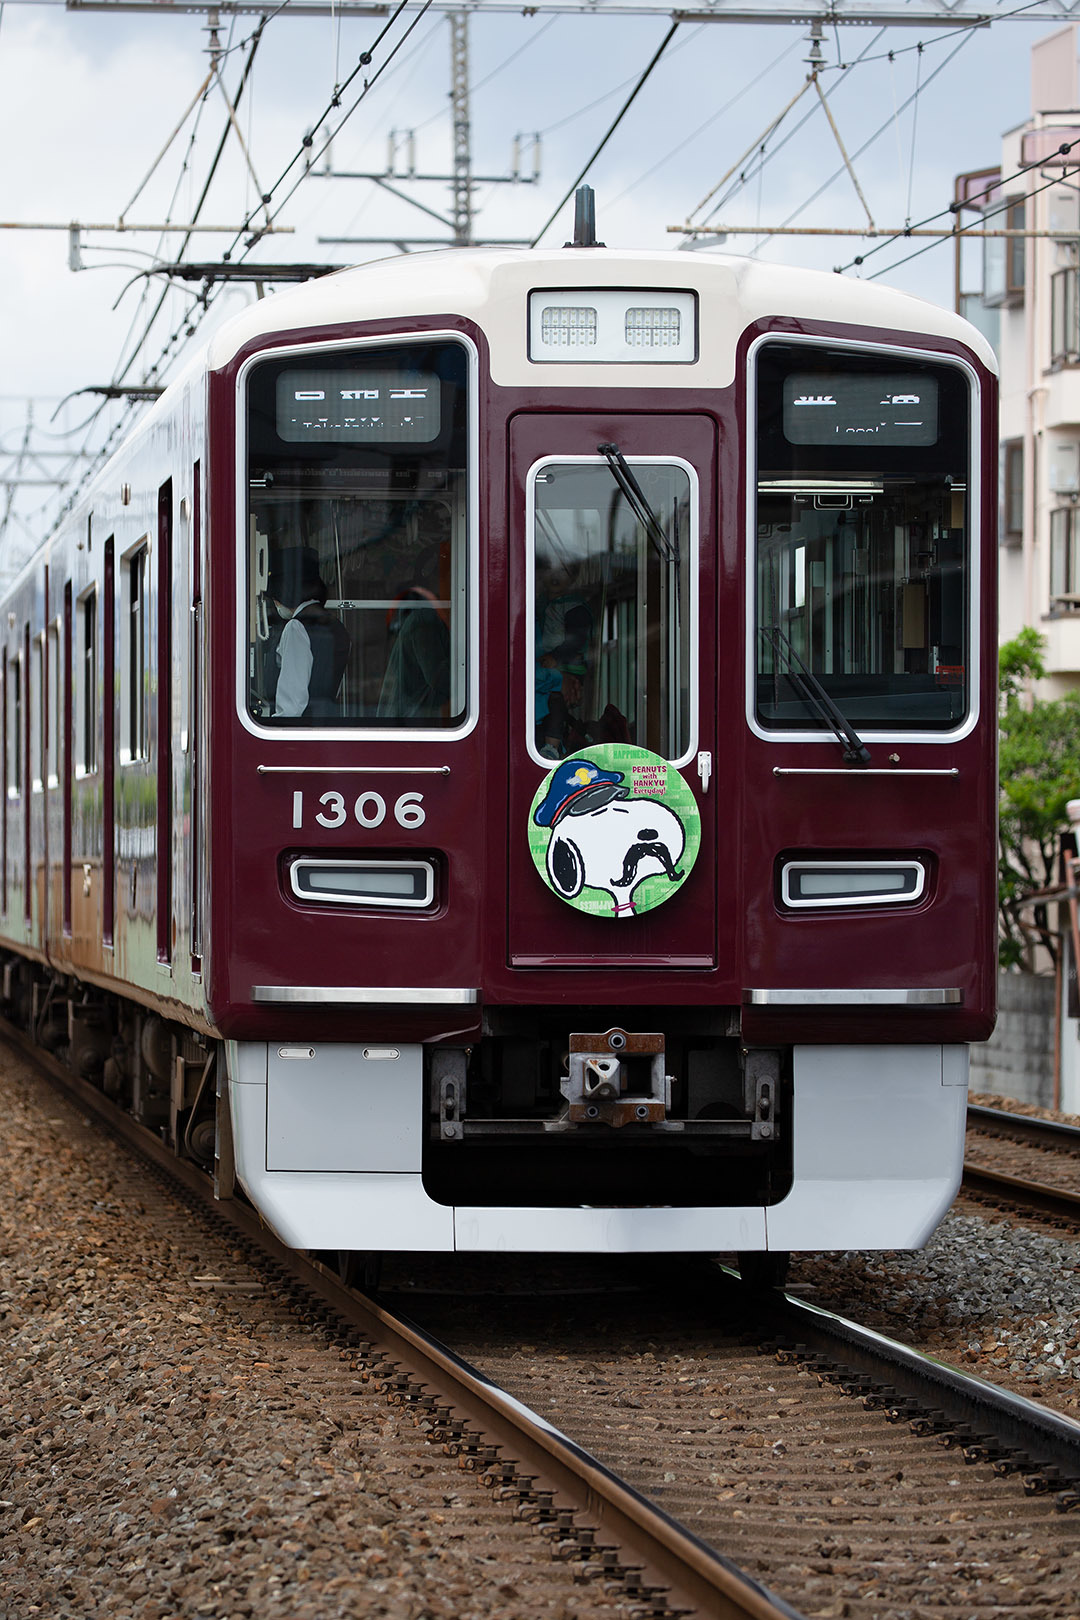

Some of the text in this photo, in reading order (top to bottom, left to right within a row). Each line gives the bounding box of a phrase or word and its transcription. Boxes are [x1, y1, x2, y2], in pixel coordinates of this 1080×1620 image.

[613, 750, 649, 760] HAPPINESS
[632, 765, 667, 773] PEANUTS
[633, 787, 666, 796] Everyday!
[292, 790, 426, 830] 1306
